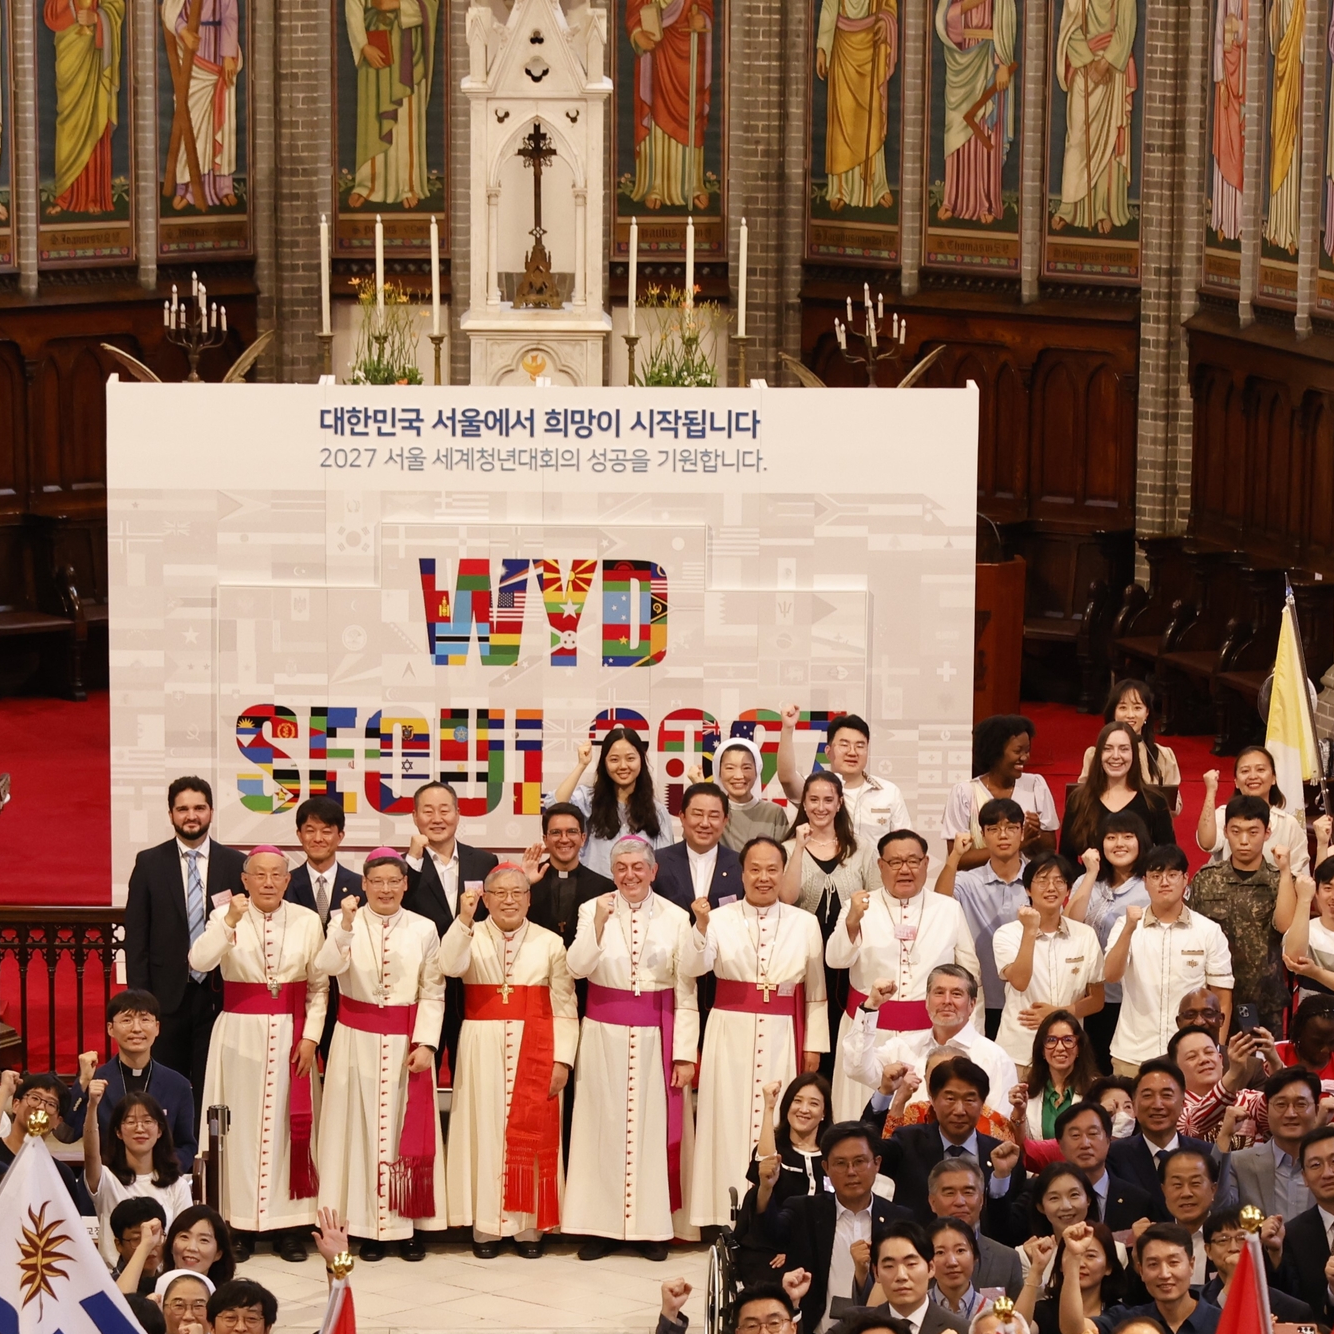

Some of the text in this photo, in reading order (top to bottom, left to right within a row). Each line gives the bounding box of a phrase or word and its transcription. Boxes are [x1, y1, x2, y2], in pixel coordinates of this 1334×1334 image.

[320, 407, 760, 439] 대한민국 서울에서 희망이 시작됩니다
[321, 447, 767, 473] 2027 서울 세계청년대회의 성공을 기원합니다.
[419, 558, 667, 667] WYD
